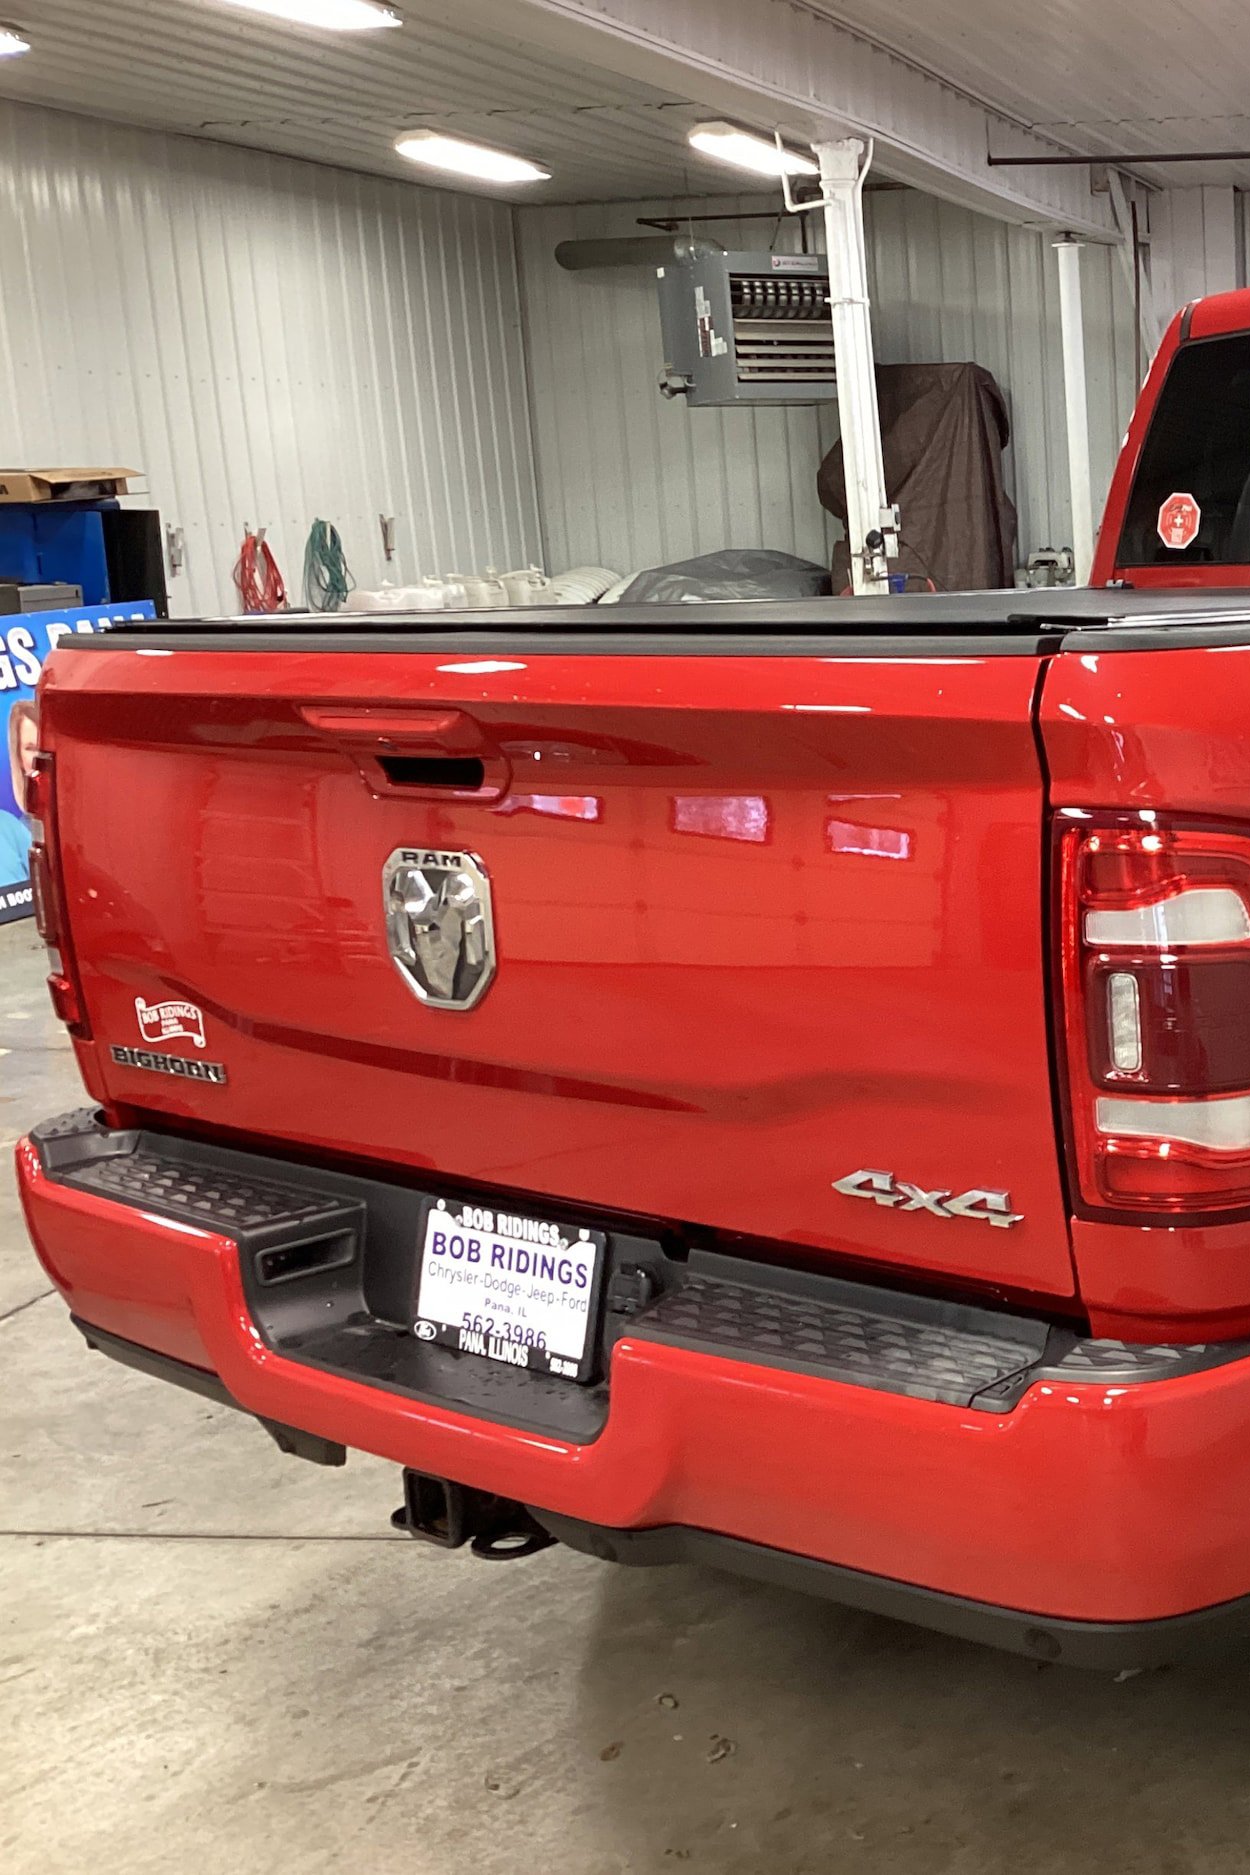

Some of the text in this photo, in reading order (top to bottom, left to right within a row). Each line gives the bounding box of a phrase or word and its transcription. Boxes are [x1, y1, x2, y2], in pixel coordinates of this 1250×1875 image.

[402, 851, 462, 867] RAM
[142, 1010, 159, 1024] BOB
[159, 1006, 197, 1020] RIDINGS
[111, 1045, 226, 1083] BIGHORN
[462, 1206, 560, 1248] BOB RIDINGS
[432, 1231, 588, 1289] BOB RIDINGS
[462, 1312, 547, 1350] 562-3986
[488, 1336, 529, 1368] ILLINOIS
